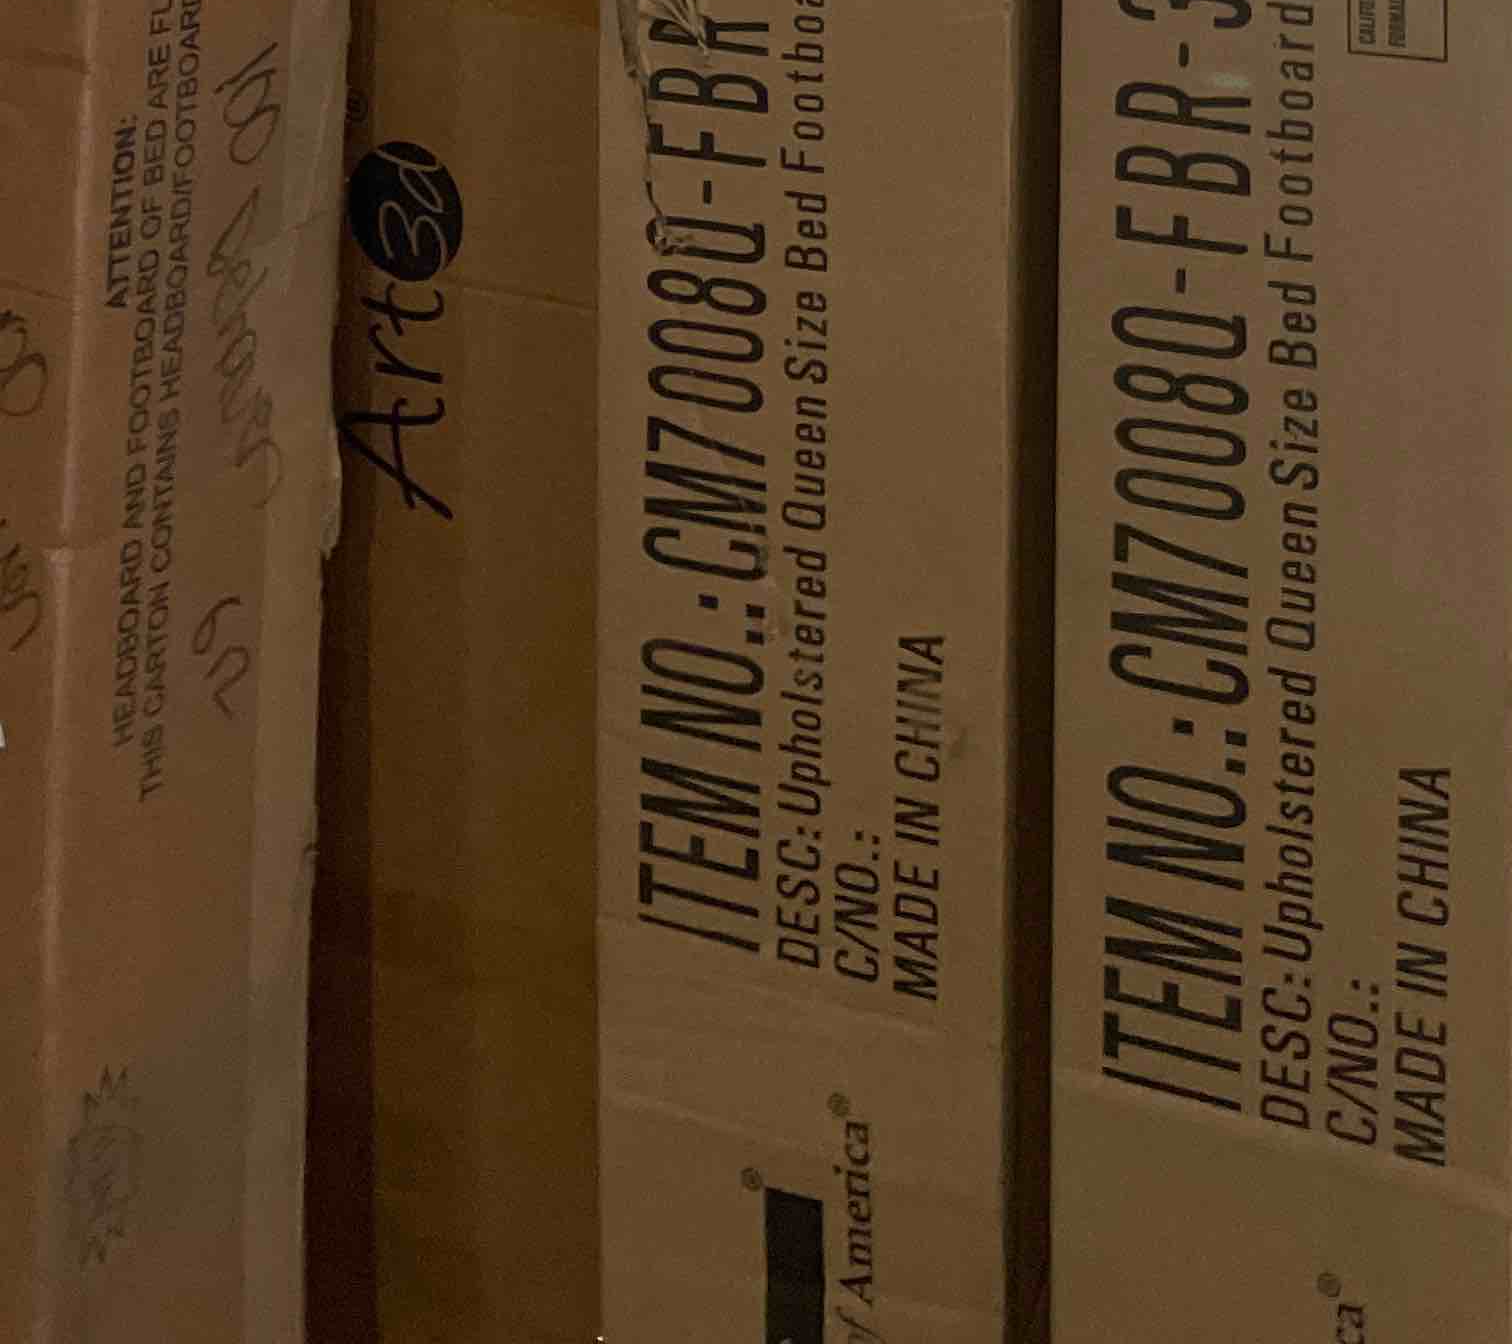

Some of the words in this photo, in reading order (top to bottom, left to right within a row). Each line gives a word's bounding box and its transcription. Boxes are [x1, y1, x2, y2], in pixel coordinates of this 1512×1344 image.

[146, 44, 172, 111] ARE
[105, 114, 139, 309] ATTENTION:
[137, 185, 166, 243] OF
[142, 120, 169, 184] BED
[783, 190, 830, 273] Bed
[127, 250, 162, 454] FOOTBOARD
[783, 290, 829, 383] Size
[1269, 281, 1321, 369] Bed
[119, 462, 146, 529] AND
[148, 414, 177, 575] CONTAINS
[781, 395, 829, 532] Queen
[1269, 388, 1321, 489] Size
[110, 540, 144, 746] HEADBOARD
[1267, 501, 1322, 652] Queen
[141, 582, 171, 714] CARTON
[897, 632, 943, 782] CHINA
[137, 722, 164, 804] THIS
[895, 797, 941, 846] IN
[638, 762, 764, 955] ITEM
[836, 828, 881, 983] C/NO.:
[1397, 764, 1450, 929] CHINA
[895, 861, 942, 1002] MADE
[1102, 884, 1246, 1114] ITEM
[1396, 944, 1447, 1000] IN
[1328, 977, 1380, 1145] C/NO.:
[1394, 1011, 1447, 1168] MADE
[832, 1120, 874, 1310] America
